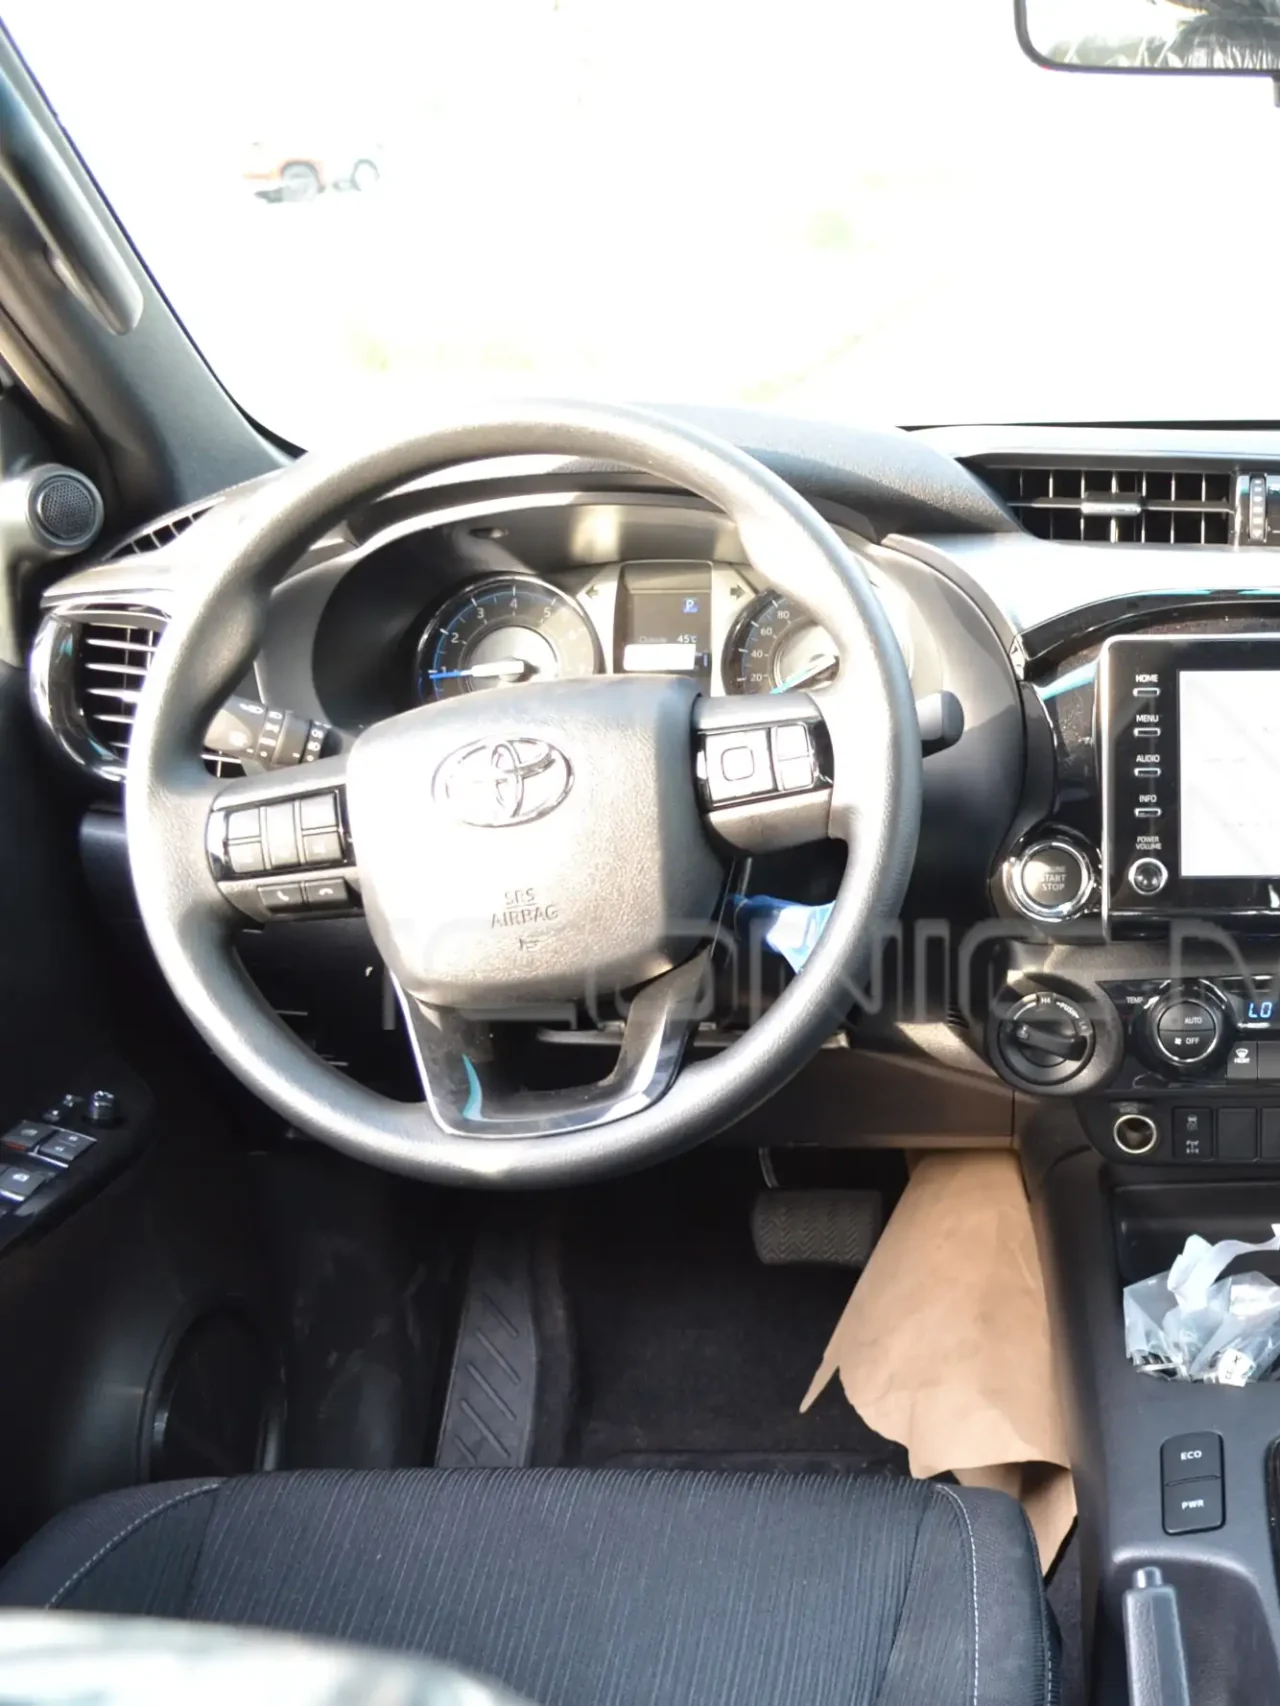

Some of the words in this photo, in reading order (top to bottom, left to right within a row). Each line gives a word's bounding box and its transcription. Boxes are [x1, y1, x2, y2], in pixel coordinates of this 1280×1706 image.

[477, 608, 485, 619] 3
[543, 606, 551, 618] 5
[777, 610, 790, 620] 80
[760, 627, 773, 636] 60
[451, 632, 459, 643] 2
[751, 650, 763, 659] 40
[750, 673, 763, 682] 20
[1135, 674, 1159, 682] HOME
[1136, 714, 1159, 722] MENU
[1136, 754, 1160, 762] AUDIO
[1042, 883, 1065, 891] STOP
[491, 904, 559, 929] AIRBAG
[1126, 996, 1143, 1004] TEMP
[1184, 1017, 1202, 1025] AUTO
[1185, 1037, 1199, 1045] OFF
[1180, 1450, 1202, 1461] ECO
[1181, 1499, 1204, 1510] PWR
